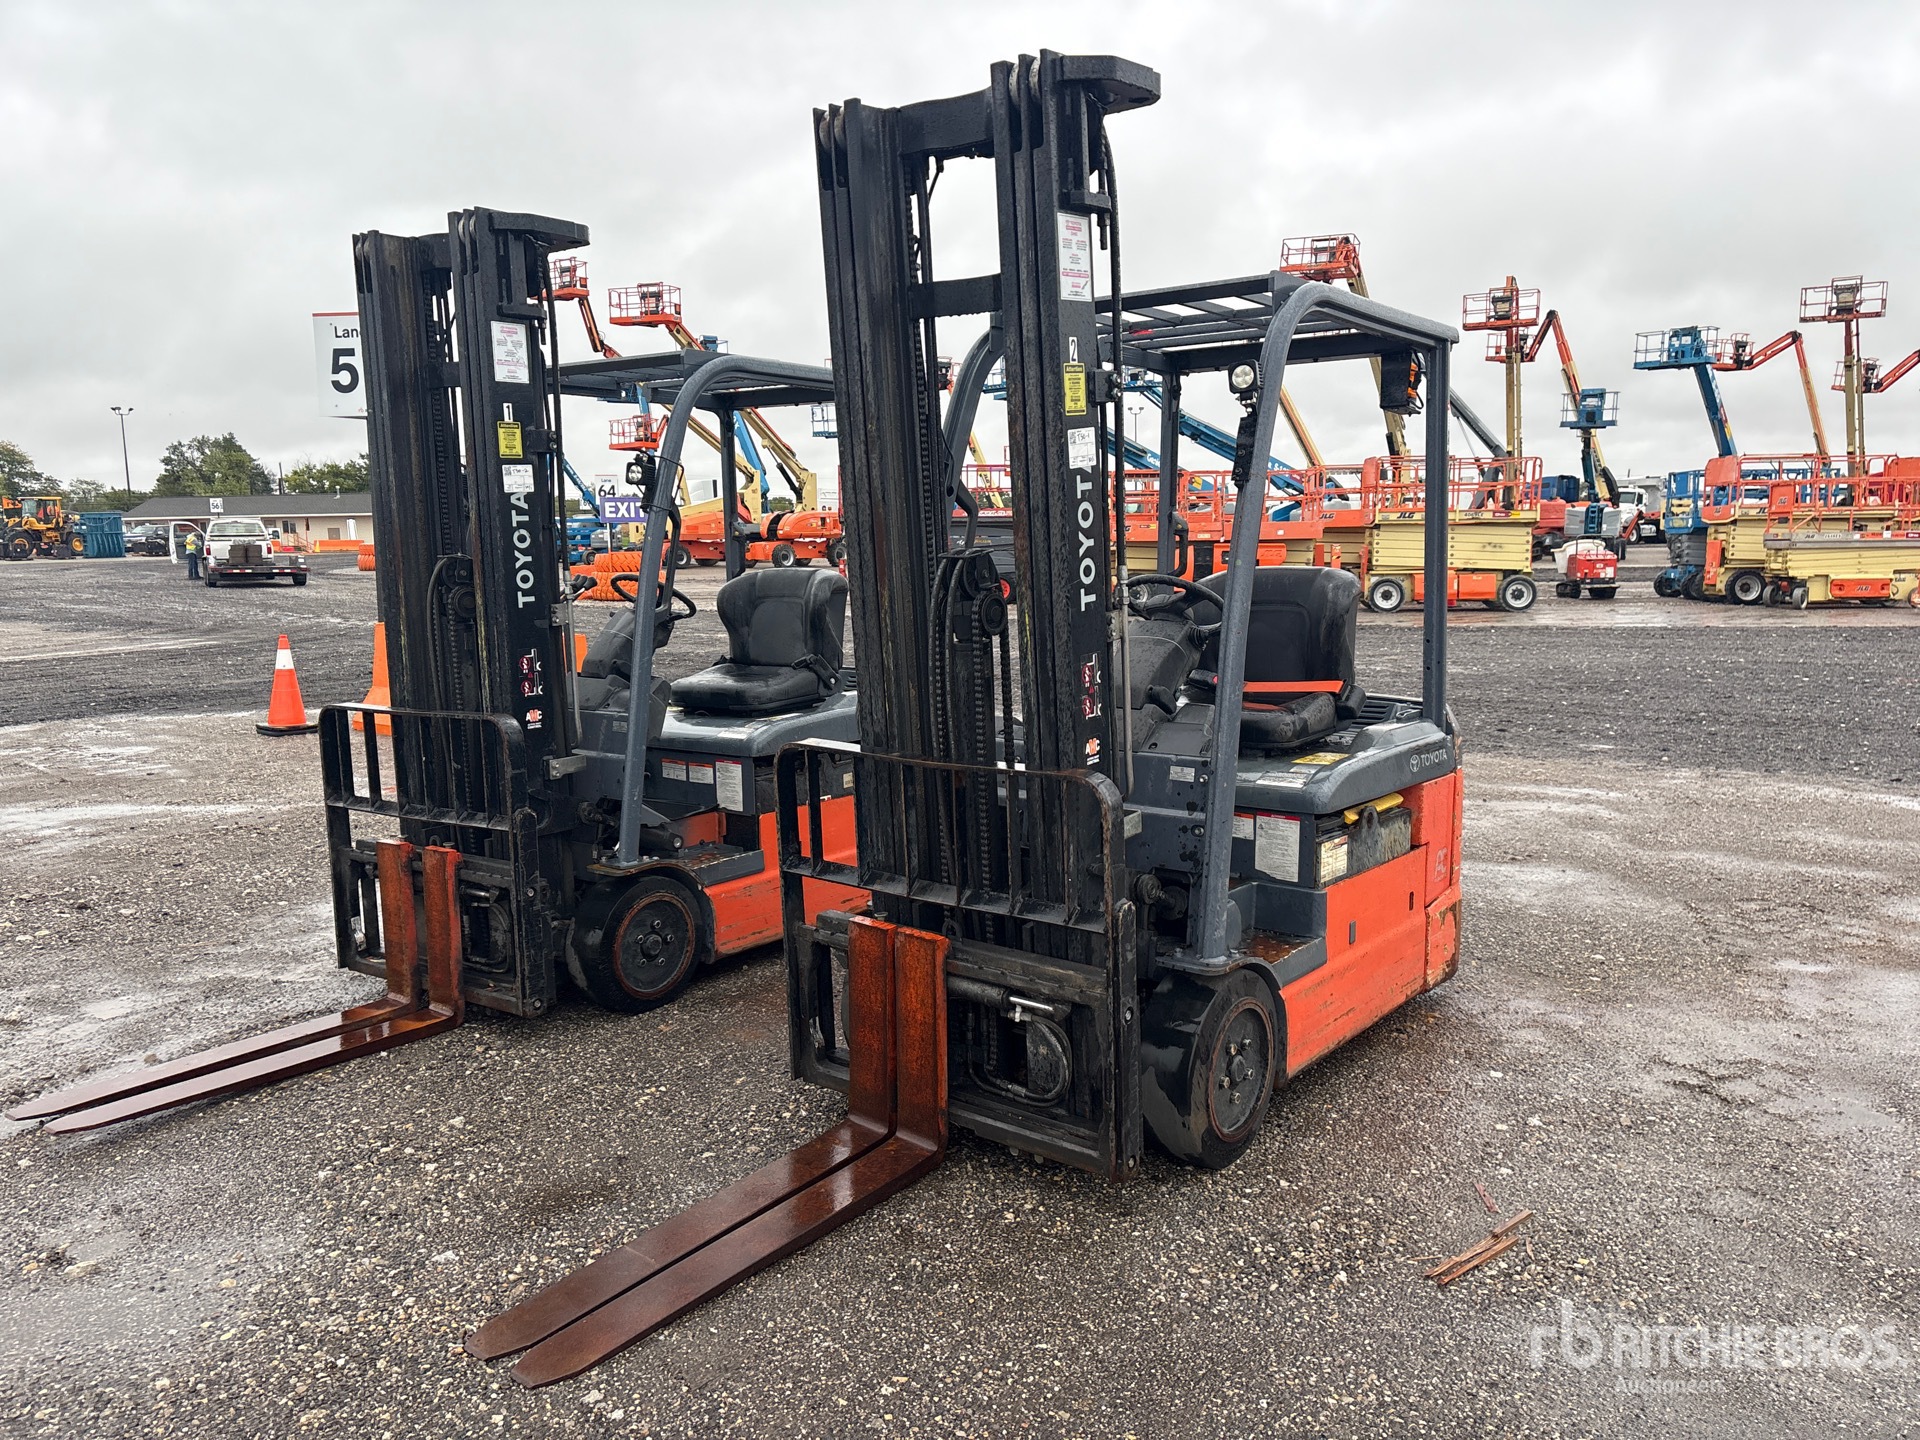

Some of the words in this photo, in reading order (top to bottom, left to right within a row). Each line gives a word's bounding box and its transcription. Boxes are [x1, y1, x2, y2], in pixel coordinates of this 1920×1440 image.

[334, 326, 361, 339] Lan
[1071, 339, 1077, 362] 2
[331, 347, 360, 394] 5
[505, 404, 512, 421] 1
[598, 484, 616, 498] 64
[211, 502, 220, 510] 56
[604, 501, 645, 518] EXIT
[1076, 466, 1097, 612] TOYOT
[510, 491, 536, 609] TOYOTA
[1420, 749, 1448, 768] TOYOTA
